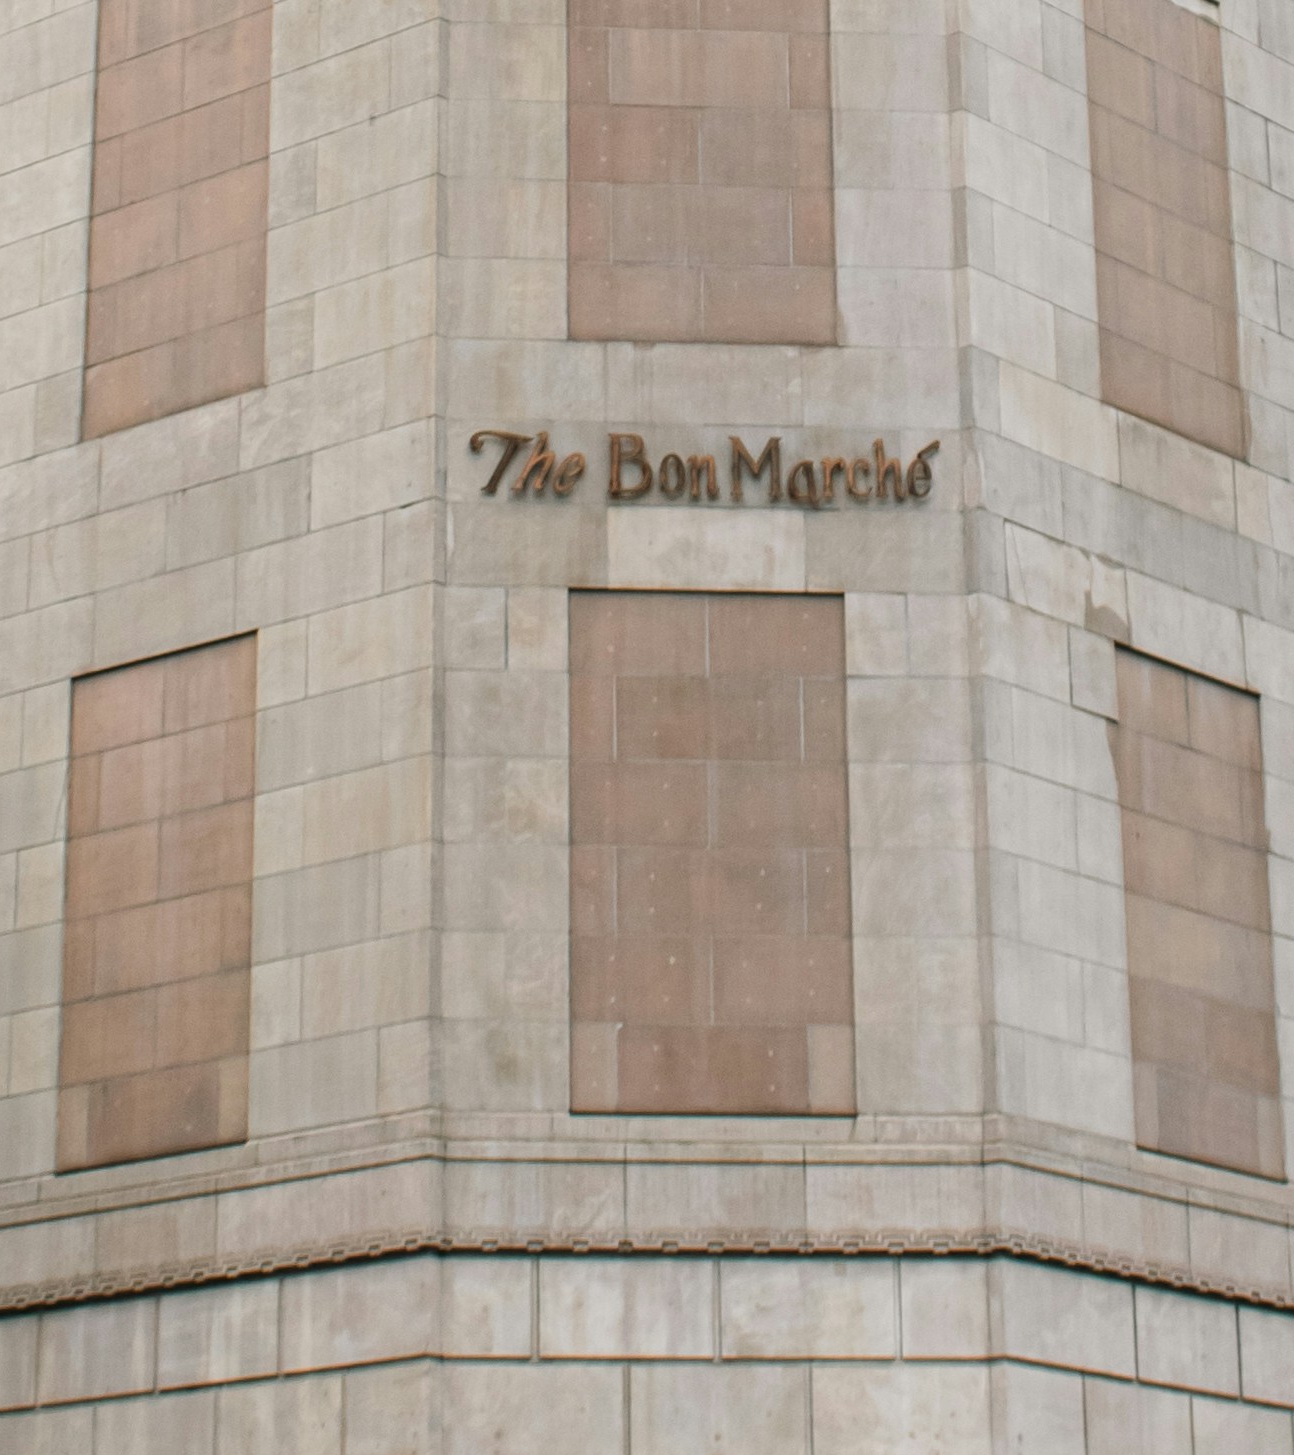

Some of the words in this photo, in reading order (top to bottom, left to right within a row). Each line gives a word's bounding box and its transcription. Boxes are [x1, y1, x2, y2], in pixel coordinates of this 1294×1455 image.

[469, 429, 586, 496] The
[608, 432, 720, 501] Bon
[728, 435, 941, 509] Marché
